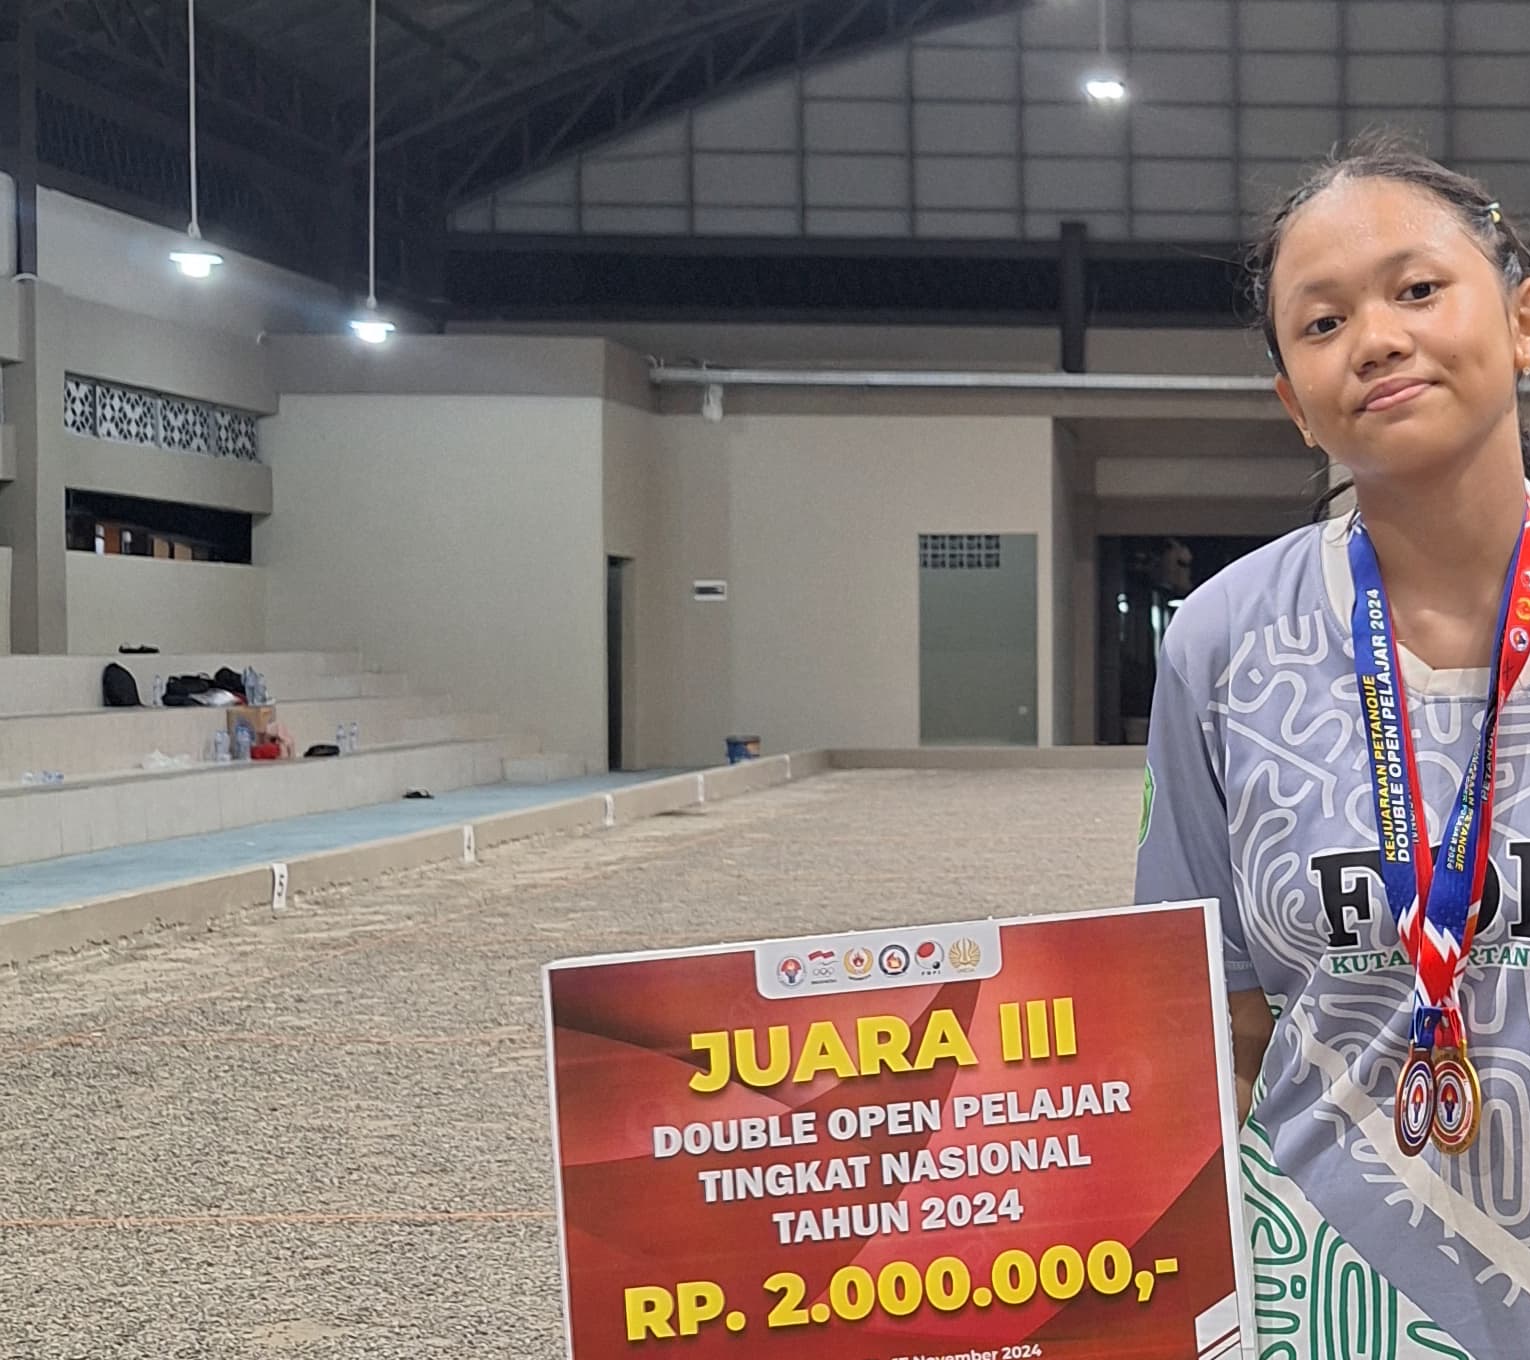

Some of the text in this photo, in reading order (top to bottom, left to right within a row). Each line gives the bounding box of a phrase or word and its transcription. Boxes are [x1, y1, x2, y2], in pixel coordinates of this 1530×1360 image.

[1365, 588, 1411, 864] DOUBLE OPEN PELAJAR 2024
[1361, 674, 1396, 863] KEJUARAAN PETANQUE
[277, 873, 285, 897] 5
[1331, 950, 1413, 974] KUTA
[689, 997, 1077, 1092] JUARA III
[653, 1081, 1131, 1158] DOUBLE OPEN PELAJAR
[699, 1134, 1092, 1203] TINGKAT NASIONAL
[773, 1188, 1023, 1245] TAHUN 2024
[623, 1240, 1179, 1341] RP. 2.000.000,-
[1002, 1343, 1043, 1360] 2024
